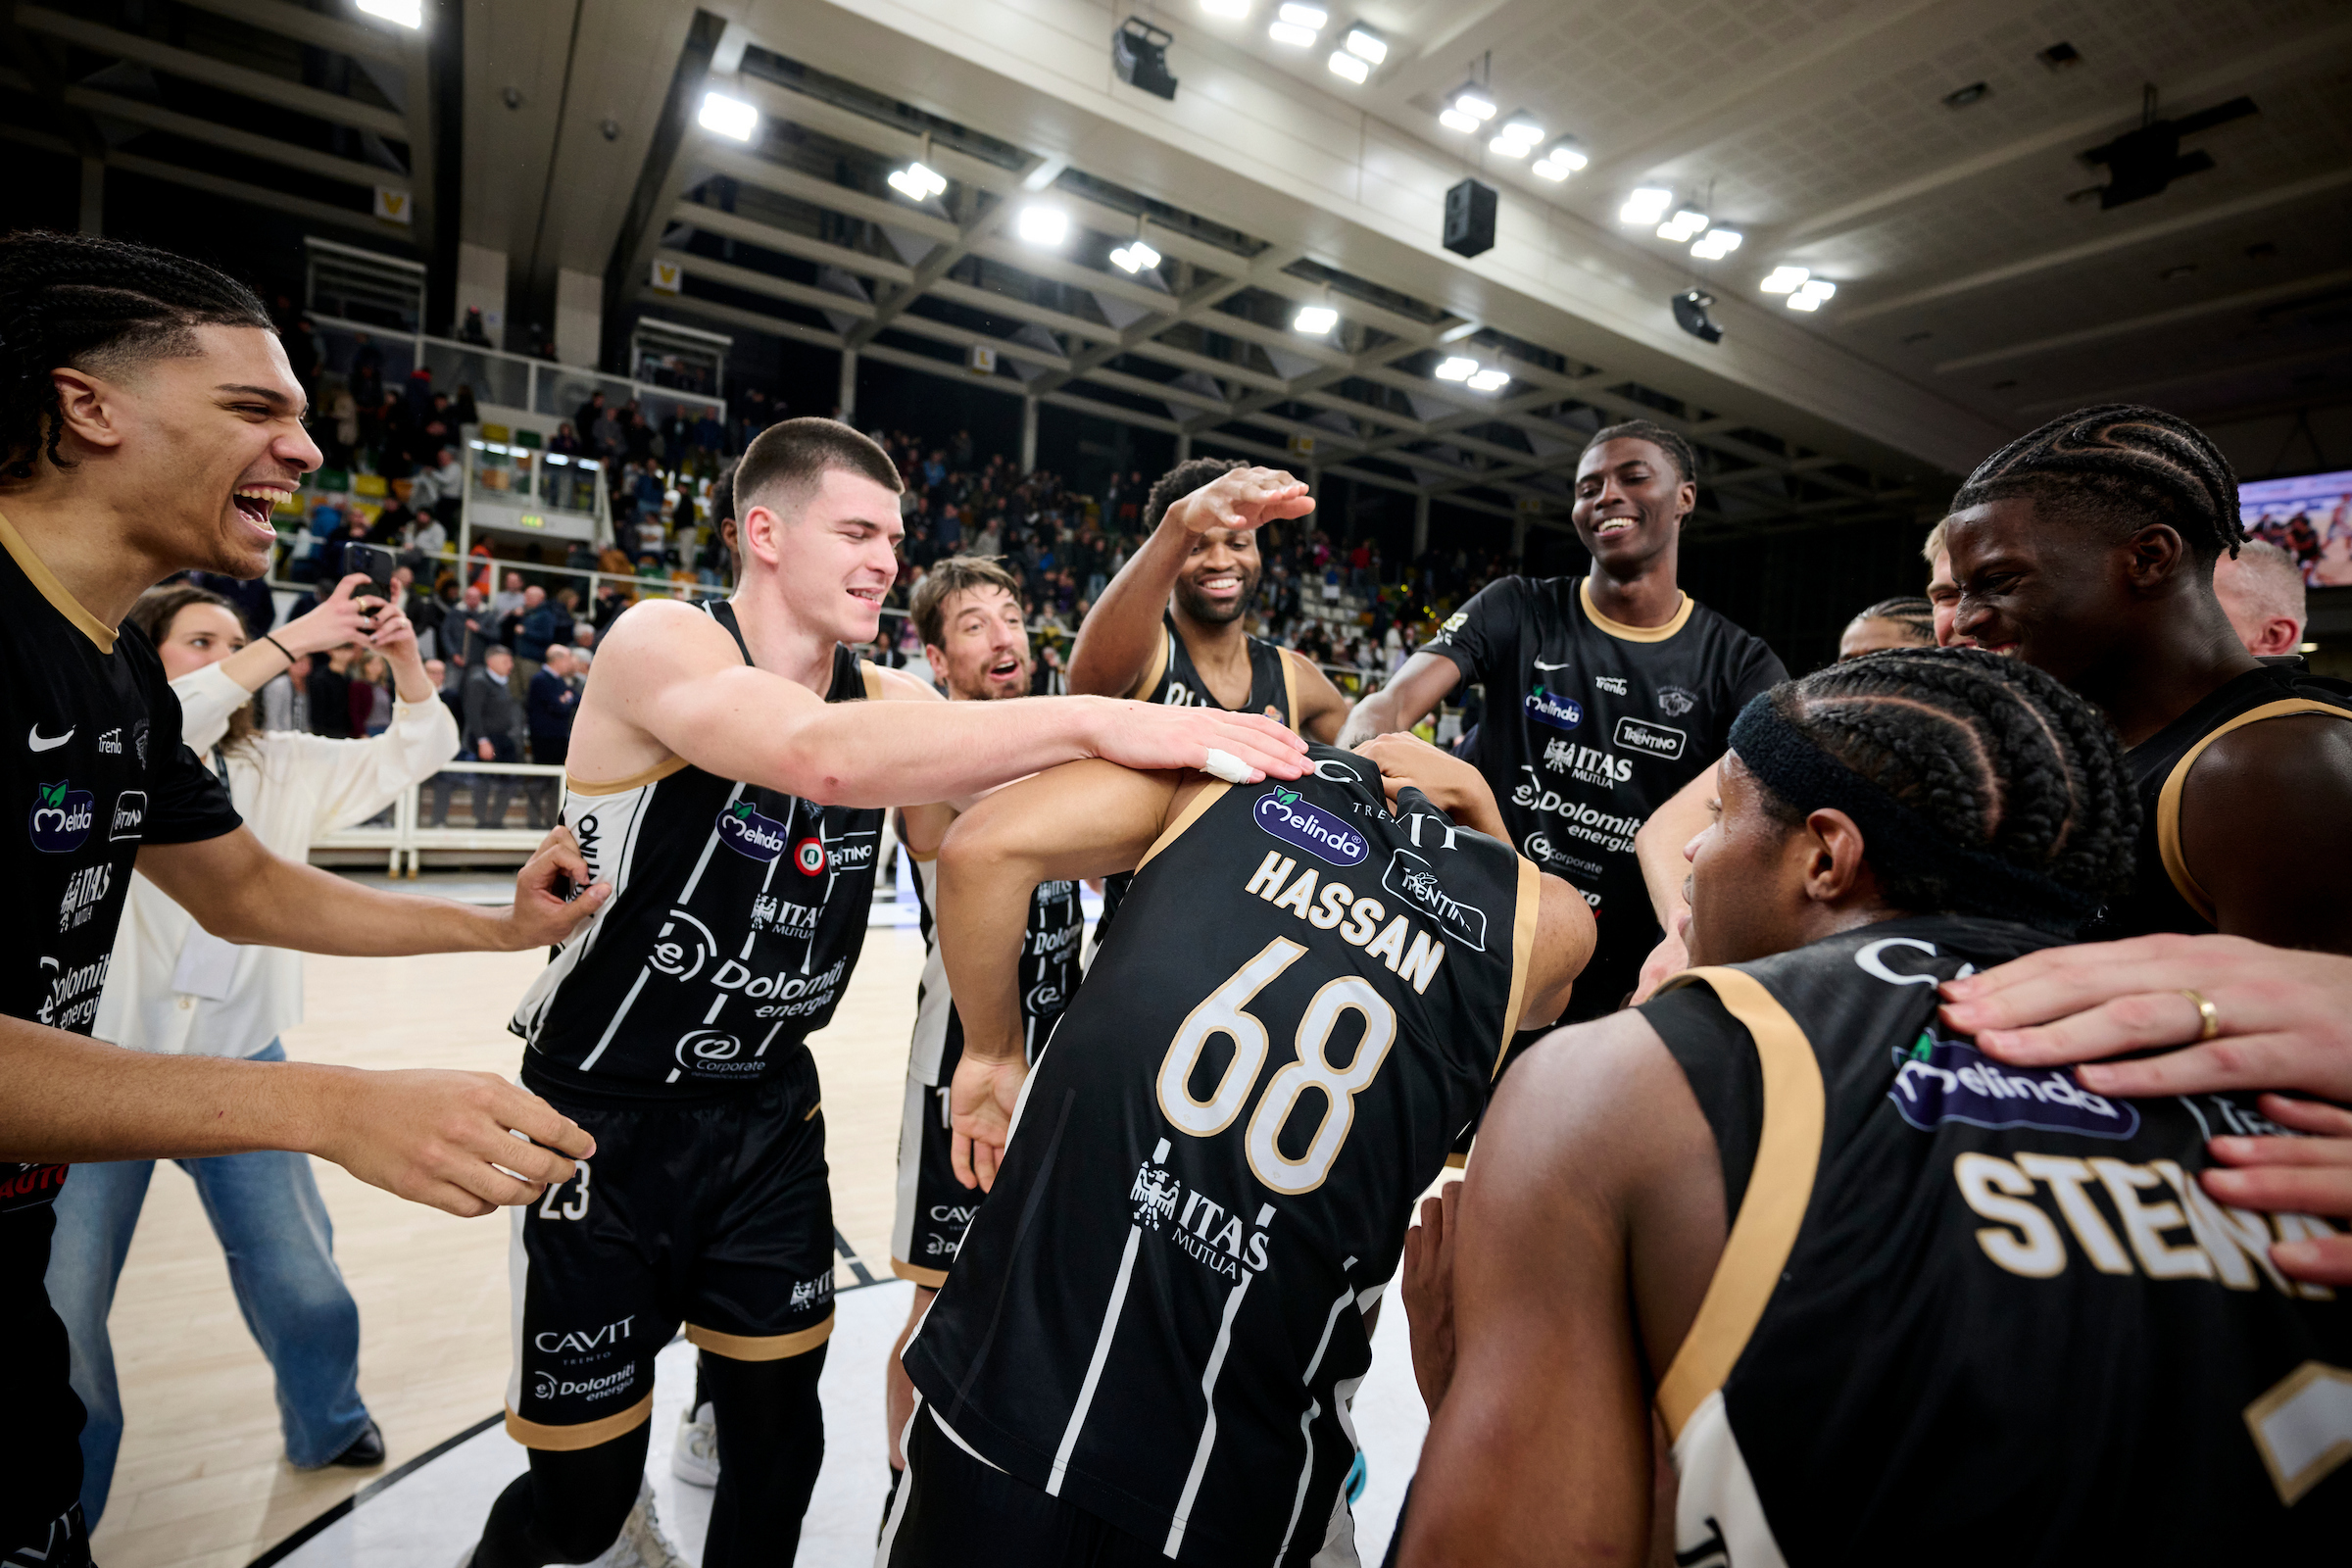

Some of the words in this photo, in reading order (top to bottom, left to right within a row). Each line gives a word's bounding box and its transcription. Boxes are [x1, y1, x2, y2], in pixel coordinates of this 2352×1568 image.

[1595, 676, 1628, 697] Trento
[1525, 694, 1580, 723] Melinda
[1623, 726, 1677, 751] TRENTINO
[1571, 767, 1614, 790] MUTUA
[1574, 746, 1634, 782] ITAS
[721, 814, 784, 853] Melinda
[1261, 798, 1361, 858] Melinda
[1539, 790, 1644, 838] Dolomit
[1567, 824, 1636, 853] energia
[1244, 850, 1446, 996] HASSAN
[710, 955, 848, 1001] Dolomiti
[755, 989, 835, 1018] energia
[696, 1058, 766, 1074] Corporate
[1155, 935, 1398, 1197] 68
[1895, 1059, 2120, 1120] Melinda
[539, 1159, 591, 1221] 23
[1178, 1189, 1270, 1272] ITAS
[1171, 1226, 1237, 1281] MUTUA
[534, 1314, 636, 1353] CAVIT
[560, 1360, 636, 1396] Dolomiti
